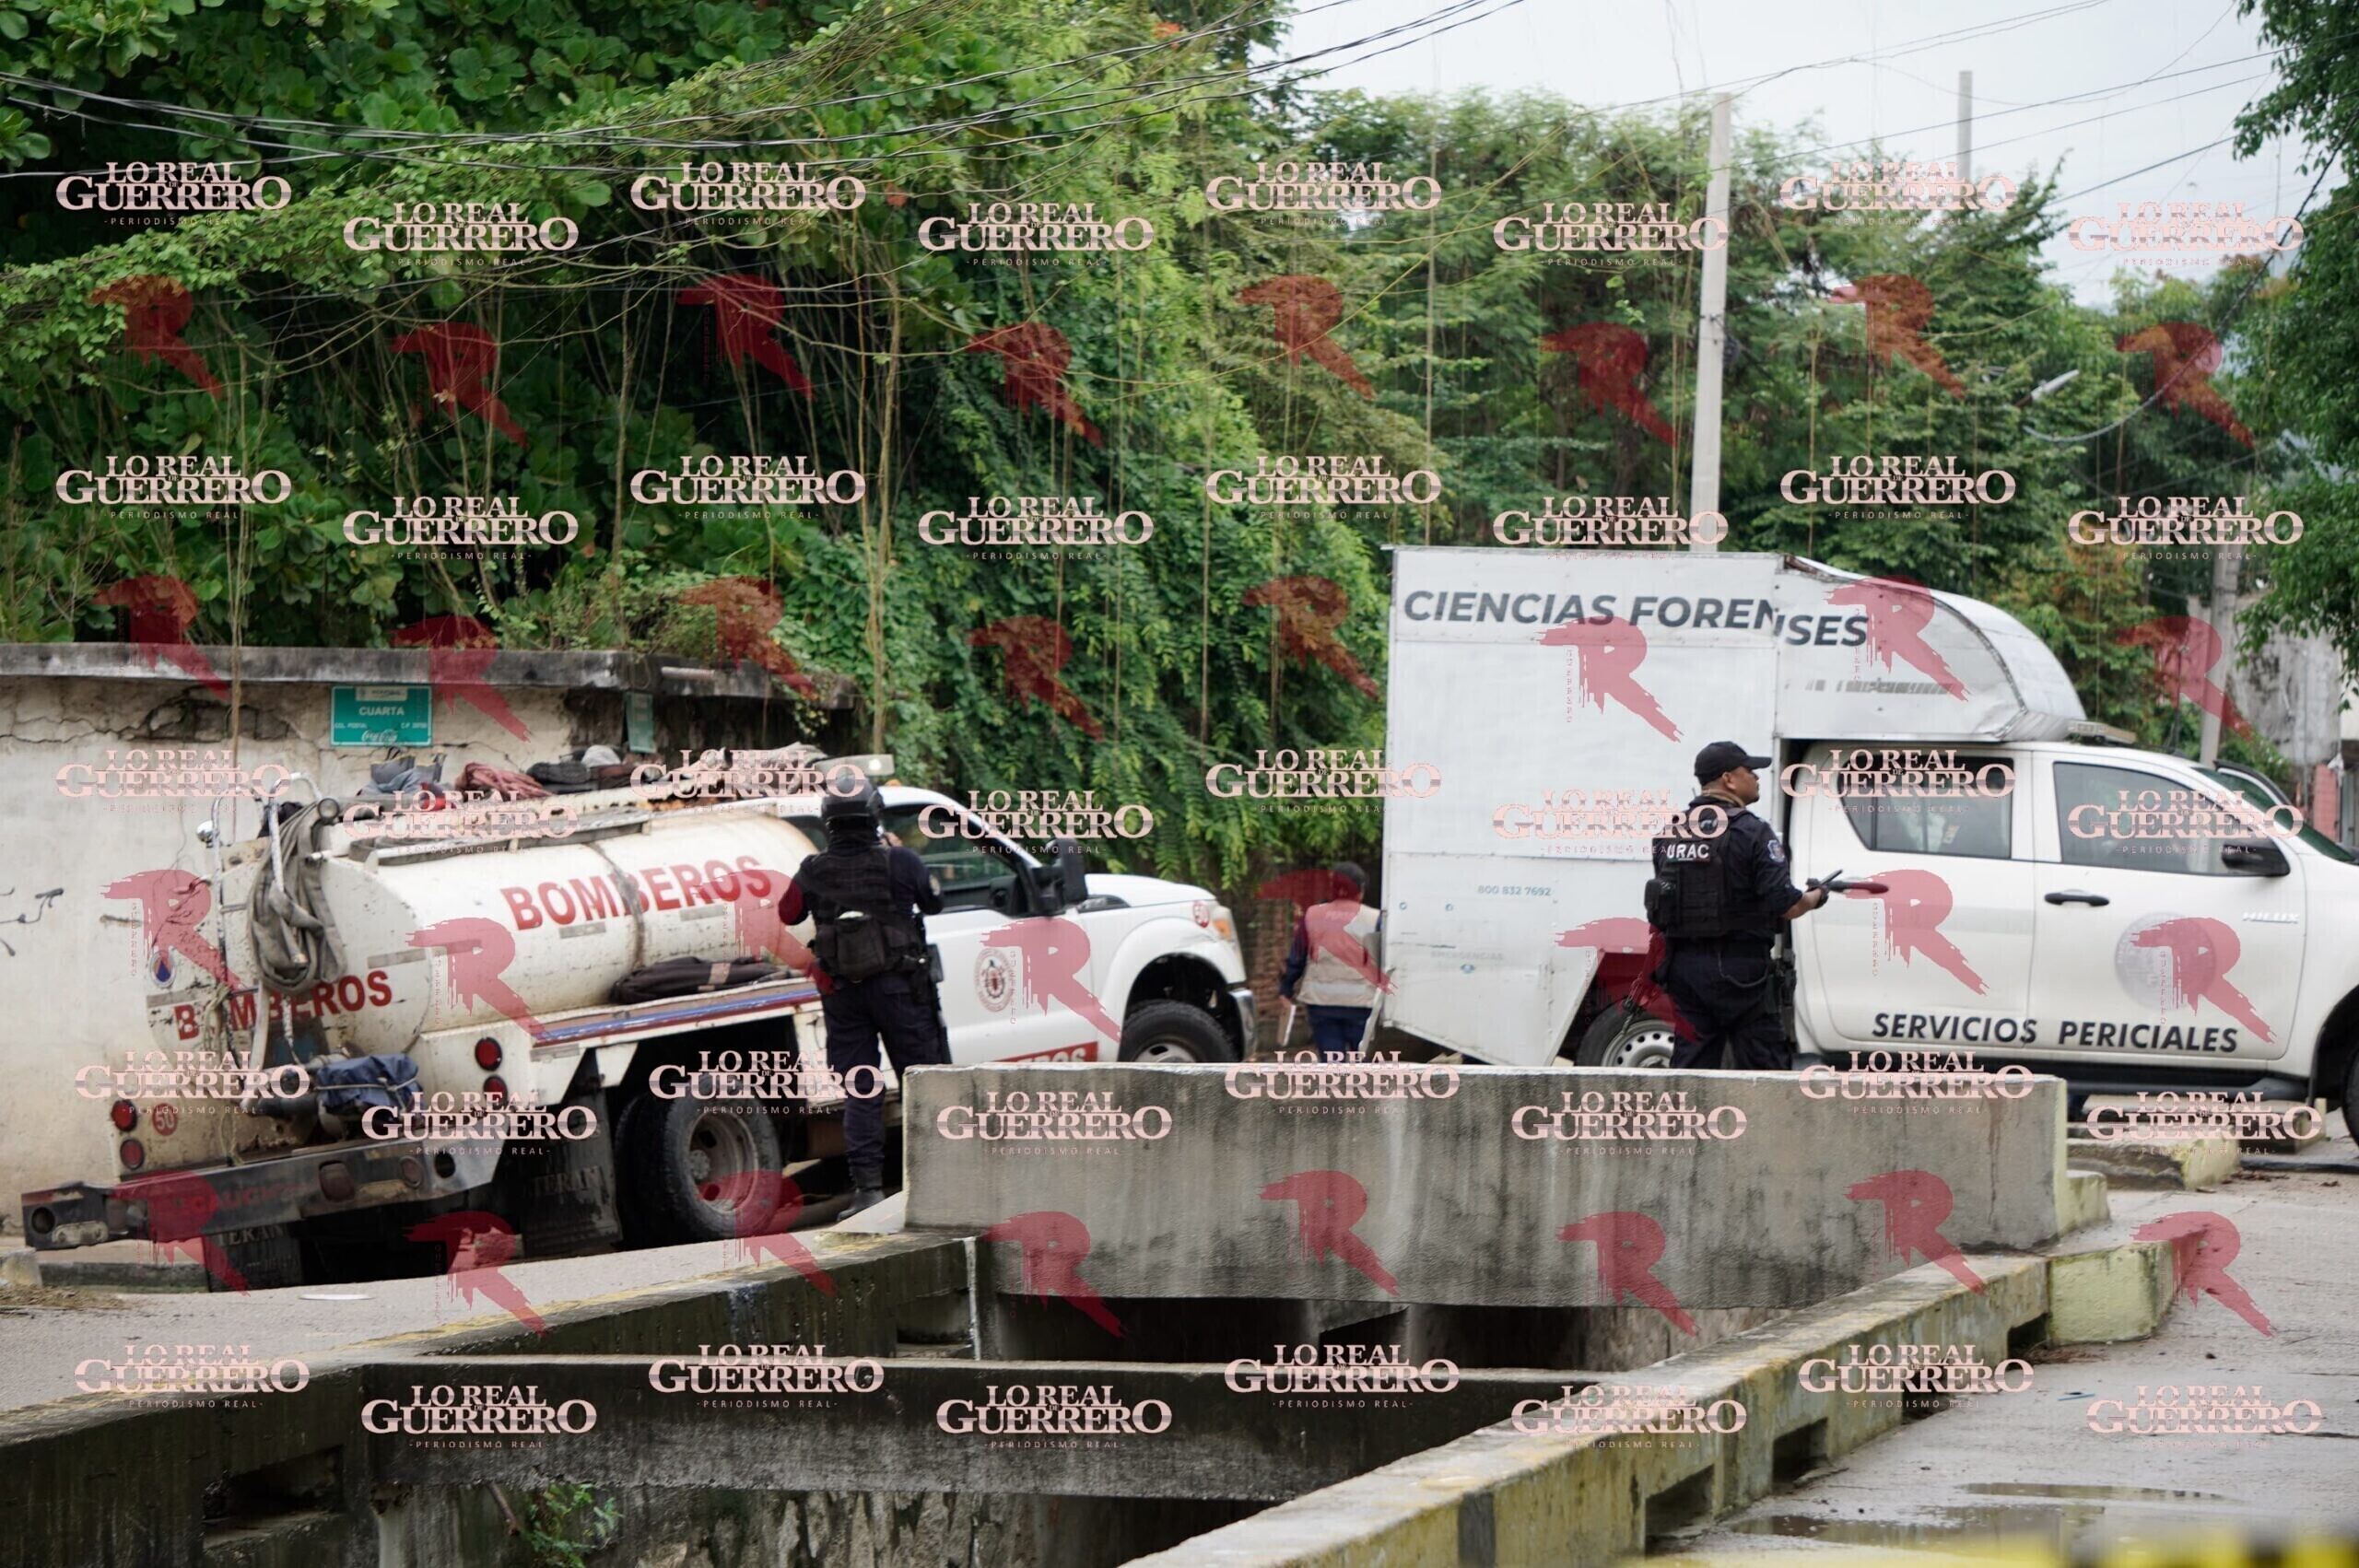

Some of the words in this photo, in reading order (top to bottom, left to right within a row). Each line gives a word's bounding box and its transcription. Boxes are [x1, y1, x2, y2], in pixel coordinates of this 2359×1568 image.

[1403, 591, 1616, 626] CIENCIAS
[1629, 595, 1869, 646] FORENSES
[358, 706, 405, 717] CUARTA
[1666, 843, 1710, 859] URAC
[499, 855, 772, 930] BOMBEROS
[174, 970, 393, 1041] BMBEROS
[1872, 1012, 2037, 1044] SERVICIOS
[2059, 1021, 2238, 1053] PERICIALES
[155, 1108, 176, 1130] 50
